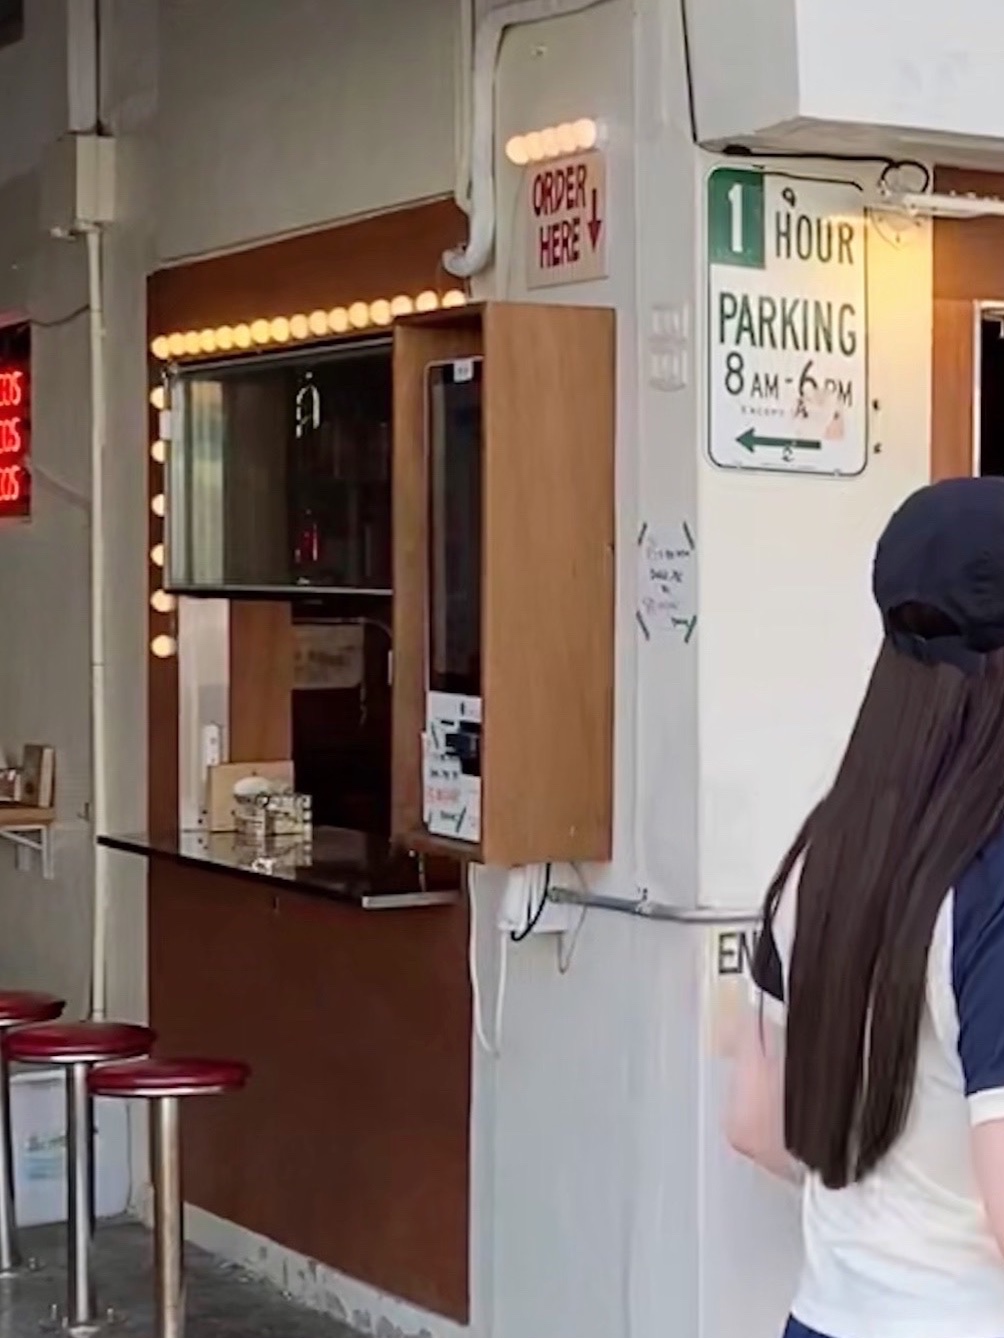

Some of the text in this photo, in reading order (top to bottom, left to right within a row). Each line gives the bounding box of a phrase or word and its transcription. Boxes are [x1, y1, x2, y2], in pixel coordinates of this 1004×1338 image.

[532, 164, 588, 217] ORDER
[539, 218, 581, 268] HERE
[727, 183, 855, 264] 1 HOUR
[718, 292, 857, 357] PARKING
